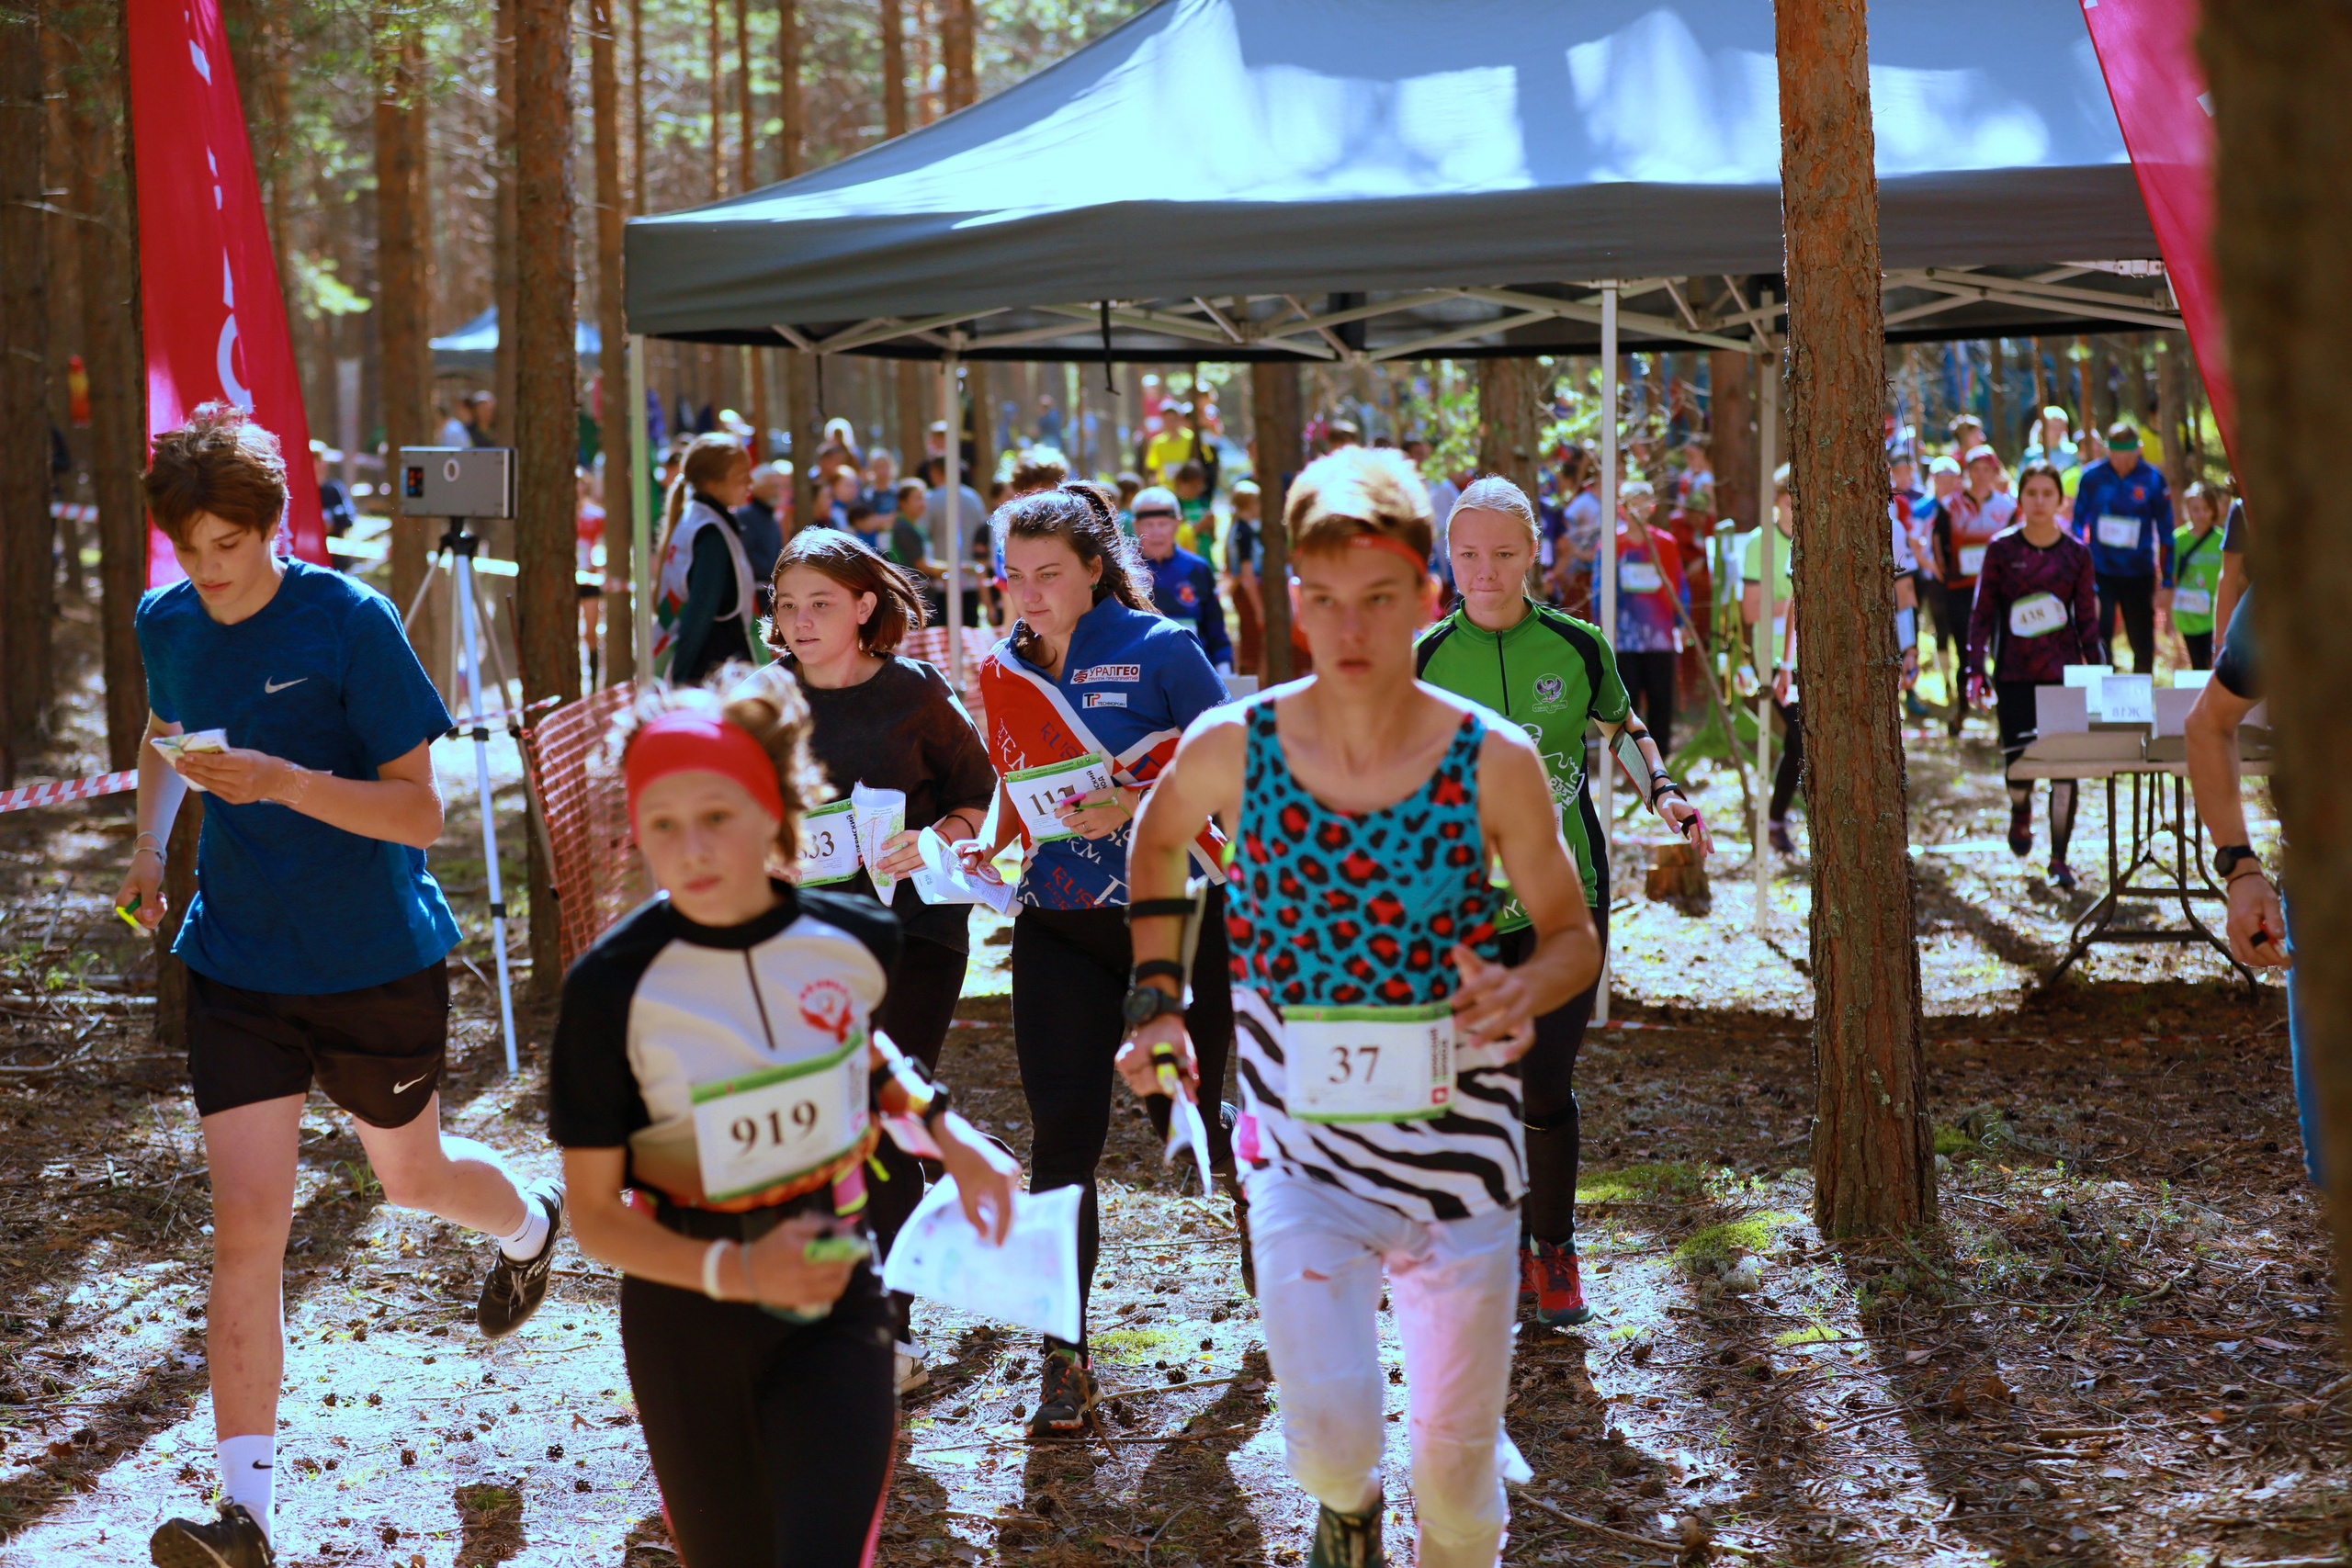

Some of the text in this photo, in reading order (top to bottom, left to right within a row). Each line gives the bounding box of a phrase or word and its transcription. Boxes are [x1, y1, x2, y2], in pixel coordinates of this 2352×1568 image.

[1090, 666, 1138, 676] УРАЛГЕО
[1329, 1045, 1381, 1084] 37
[730, 1100, 819, 1157] 919
